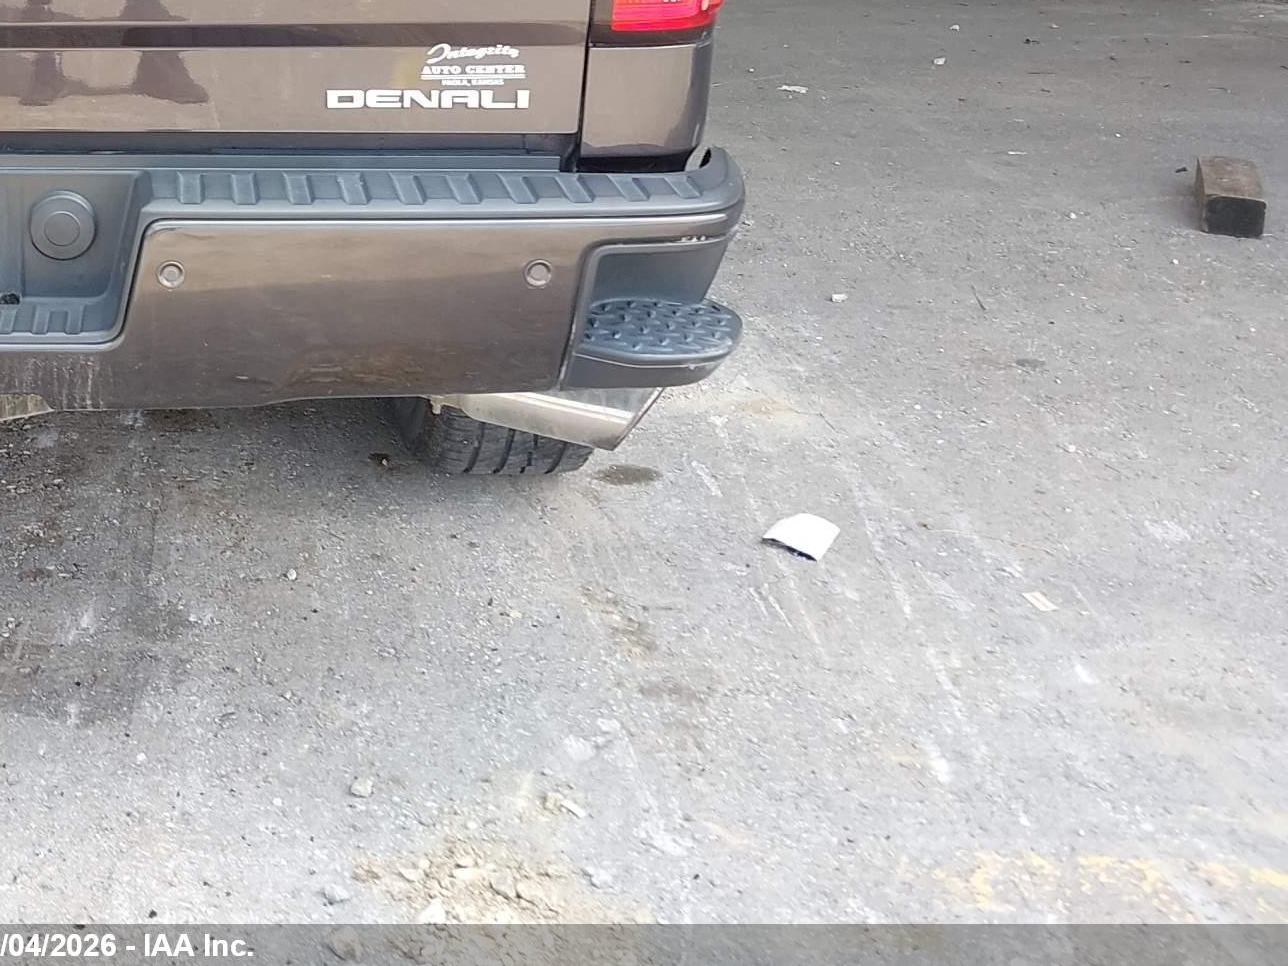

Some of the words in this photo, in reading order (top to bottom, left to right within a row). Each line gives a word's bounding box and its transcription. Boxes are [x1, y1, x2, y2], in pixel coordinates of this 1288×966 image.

[421, 65, 462, 75] AUTO
[465, 64, 526, 74] CENTER
[326, 89, 530, 109] DENALI
